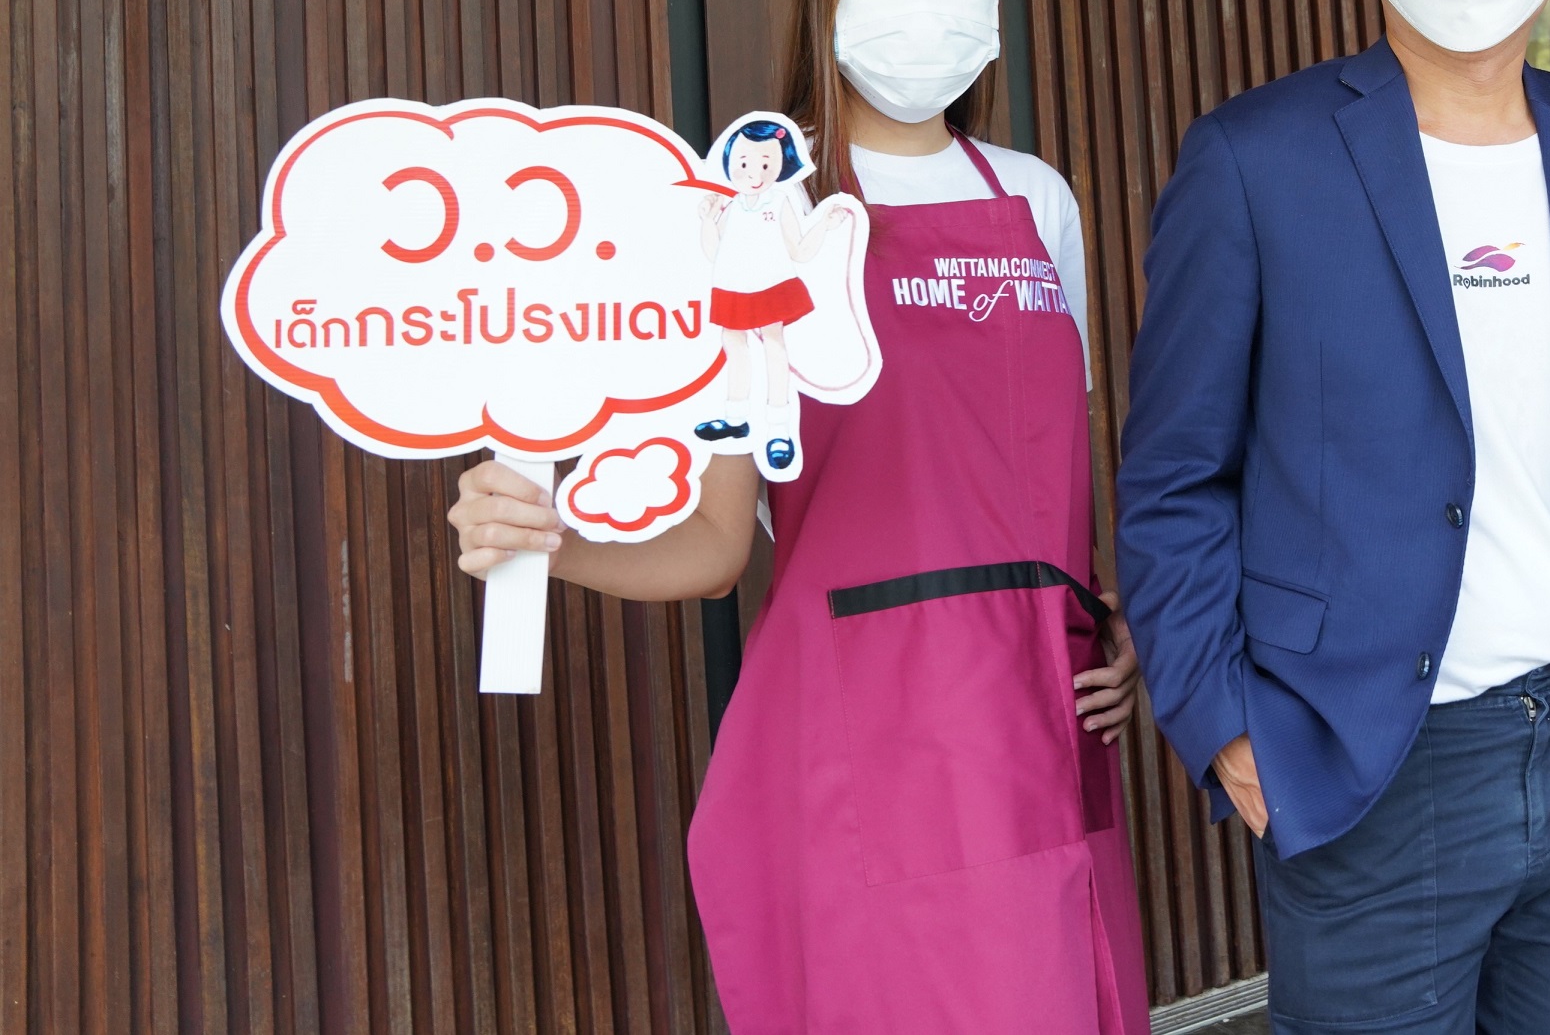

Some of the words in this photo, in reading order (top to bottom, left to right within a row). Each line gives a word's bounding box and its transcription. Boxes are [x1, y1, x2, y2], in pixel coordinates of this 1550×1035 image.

[380, 166, 617, 263] ว.ว.
[892, 277, 968, 310] HOME
[968, 279, 1013, 322] of
[1453, 274, 1531, 289] Robinhood
[274, 287, 702, 349] เด็กกระโปรงแดง
